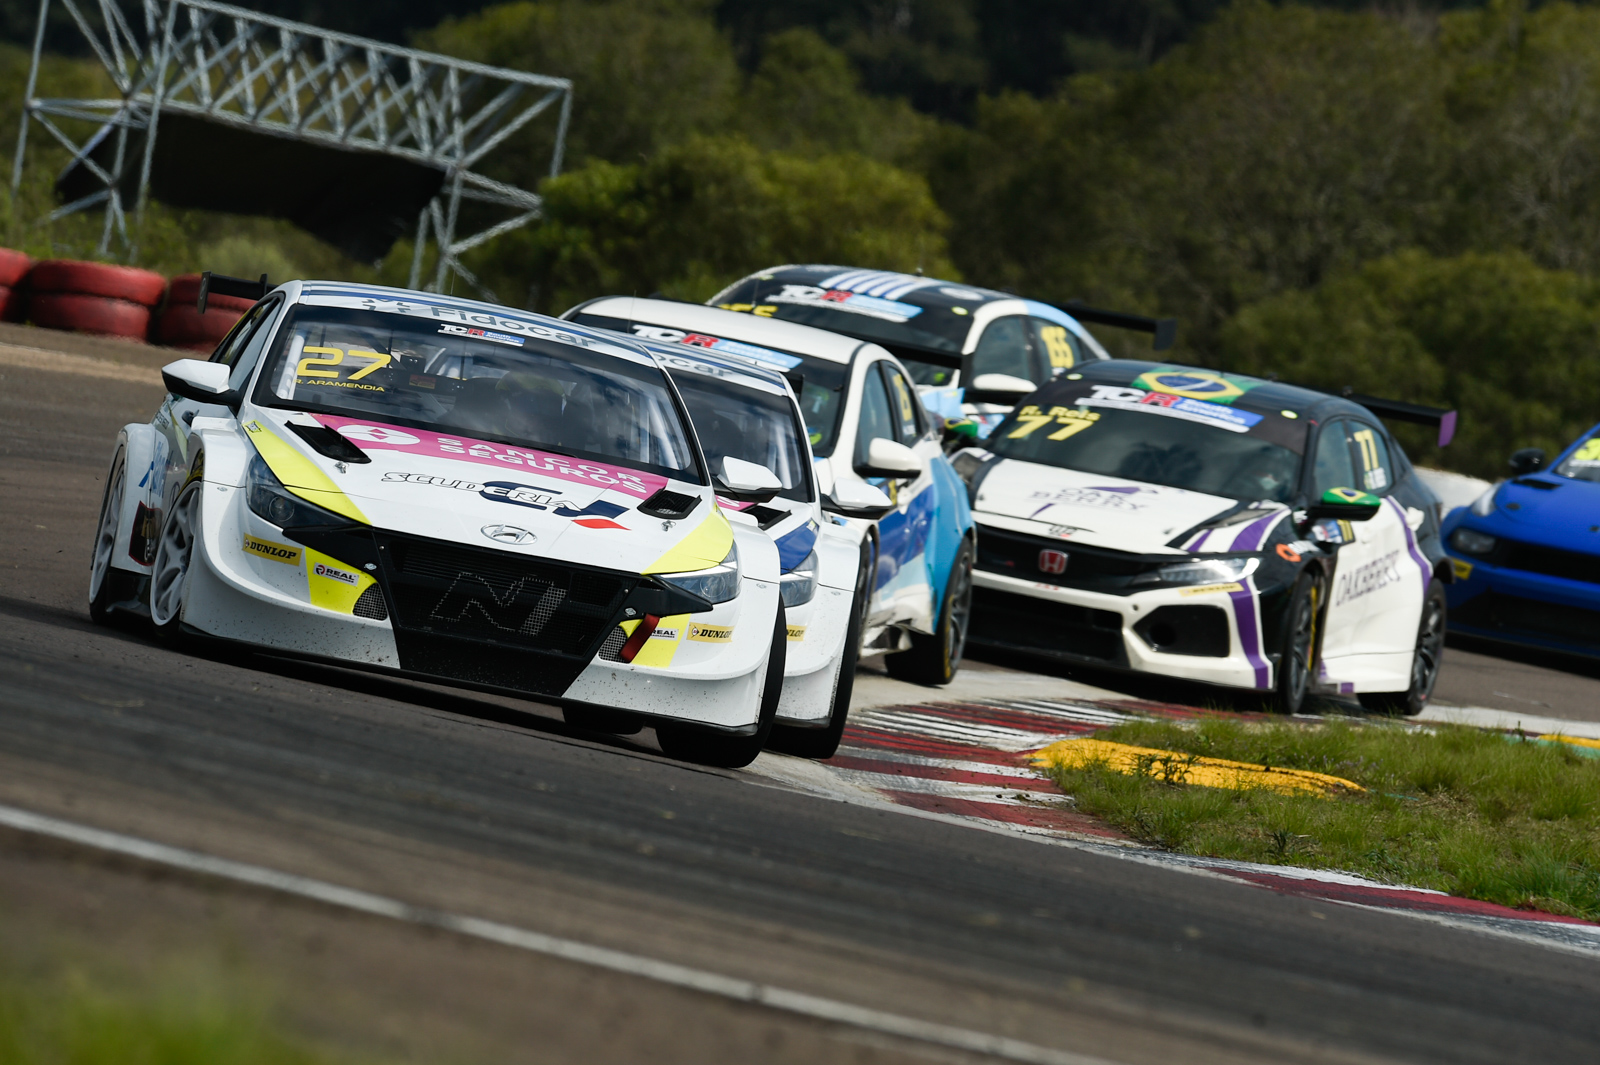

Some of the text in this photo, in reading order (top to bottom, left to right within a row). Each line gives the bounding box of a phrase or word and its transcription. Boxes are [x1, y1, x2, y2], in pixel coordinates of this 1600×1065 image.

[431, 306, 598, 347] Fidocar
[440, 323, 485, 337] TCR
[632, 324, 719, 348] TCR
[297, 346, 392, 380] 27
[306, 380, 386, 393] ARAMENDIA
[1091, 385, 1182, 408] TCR
[1007, 415, 1094, 441] 77
[437, 437, 646, 485] SANCOR
[439, 444, 648, 494] SEGUROS
[381, 471, 582, 512] SCUDERIA
[249, 541, 298, 560] DUNLOP
[326, 568, 355, 581] REAL
[700, 628, 733, 639] DUNLOP
